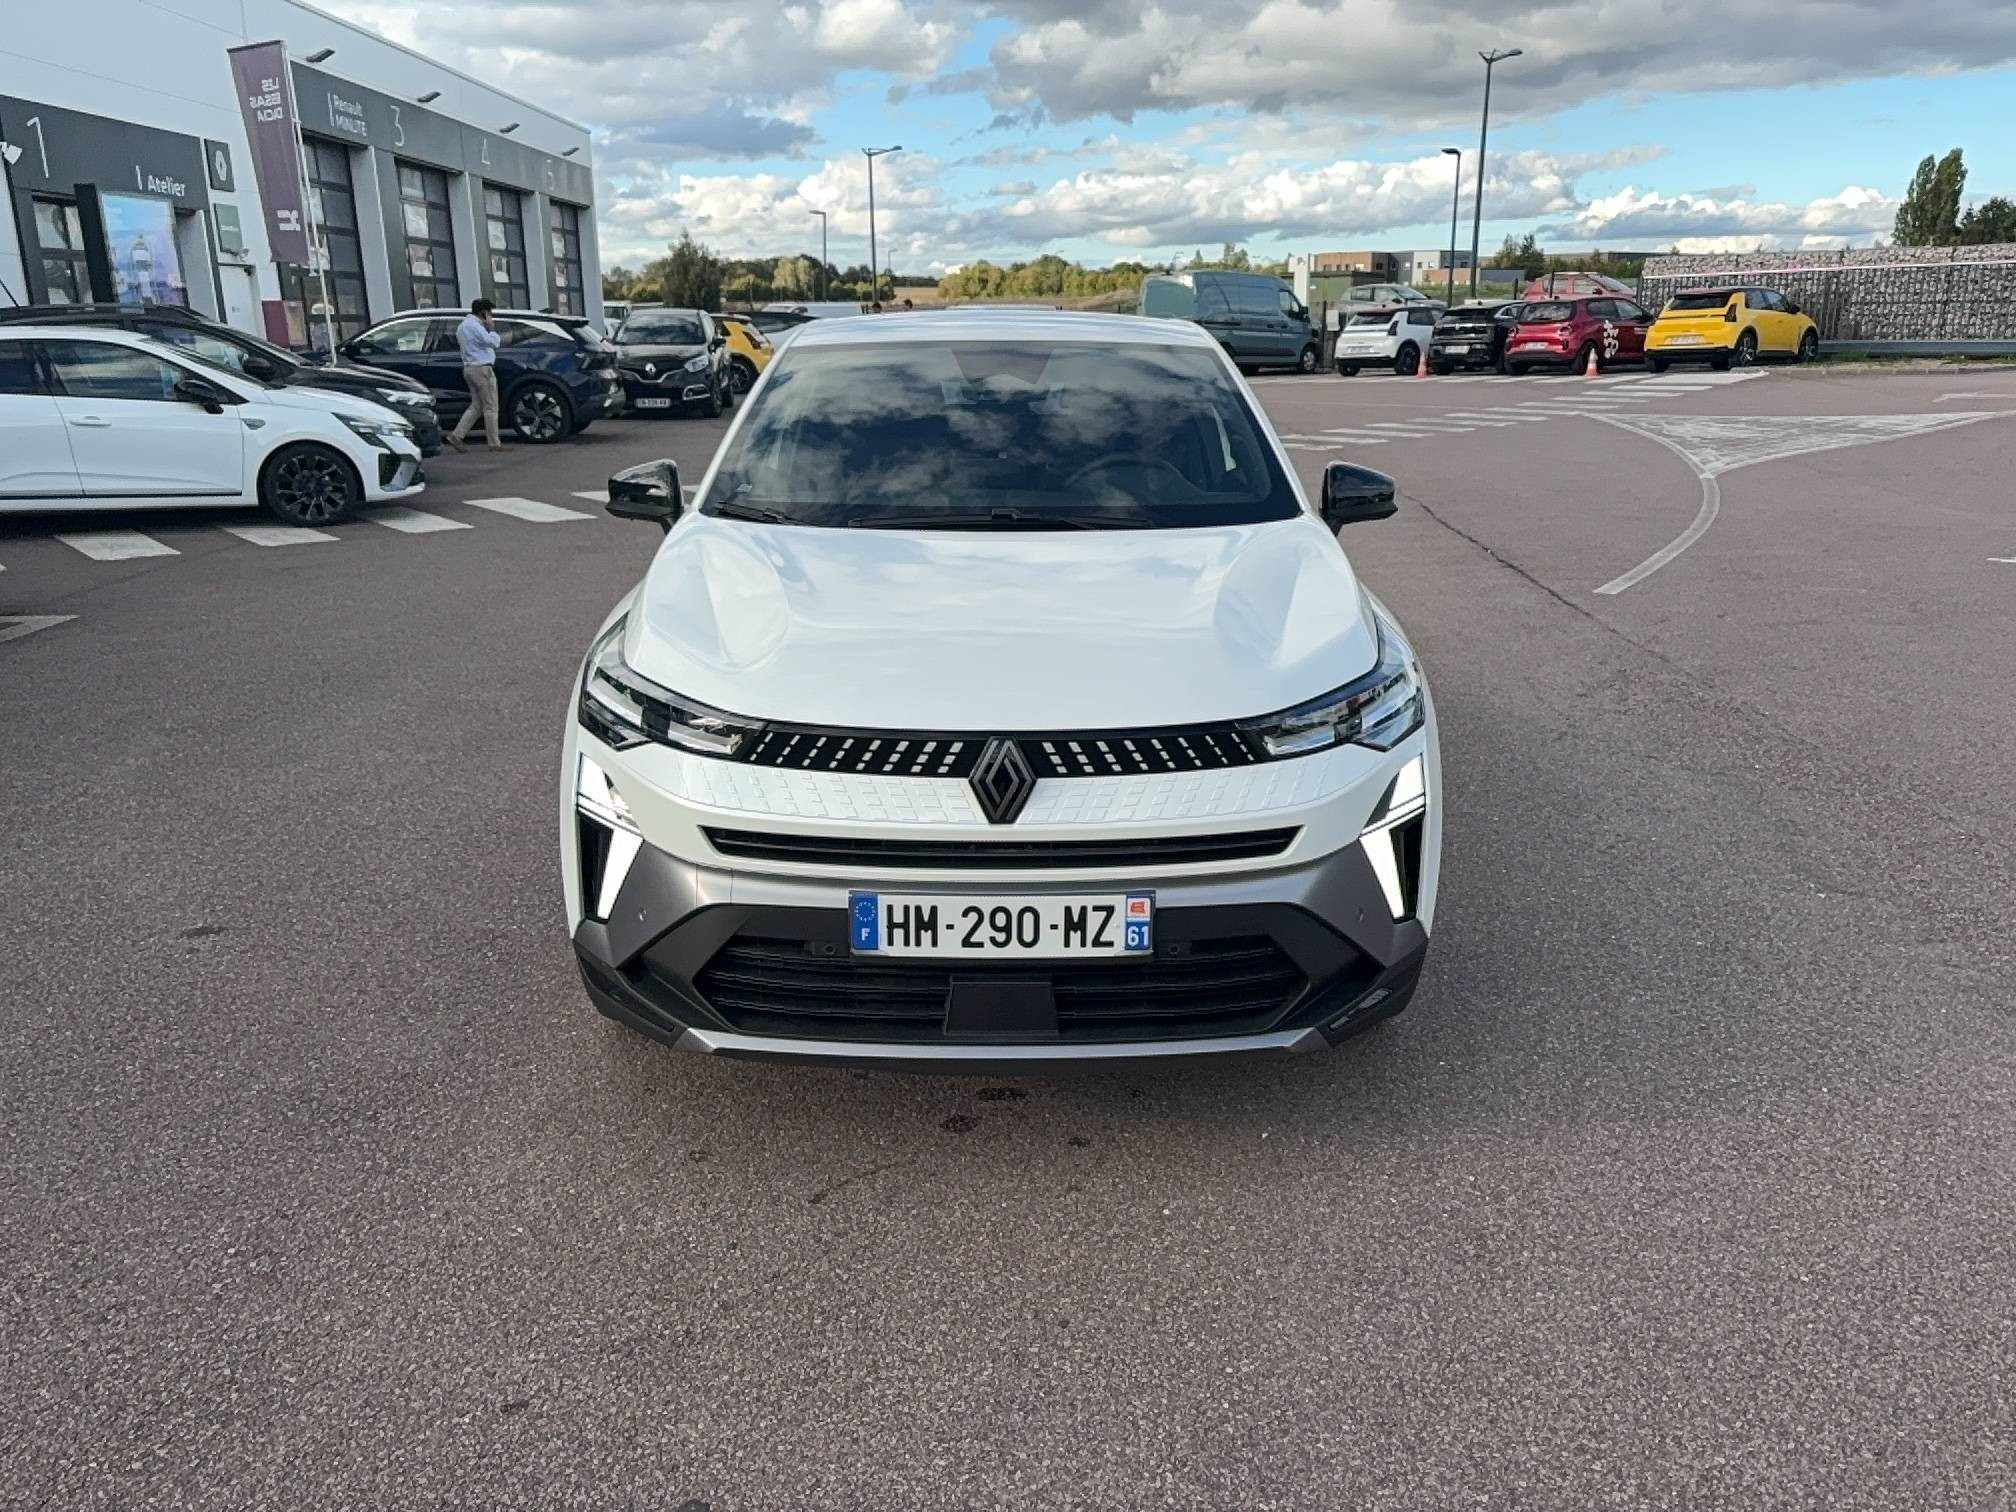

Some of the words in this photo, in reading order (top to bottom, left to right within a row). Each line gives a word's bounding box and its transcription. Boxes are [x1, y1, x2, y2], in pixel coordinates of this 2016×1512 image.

[389, 104, 405, 147] 3
[147, 174, 187, 197] Atelier
[861, 928, 871, 942] F
[886, 904, 1115, 948] HM-290-MZ
[1127, 925, 1149, 947] 61
